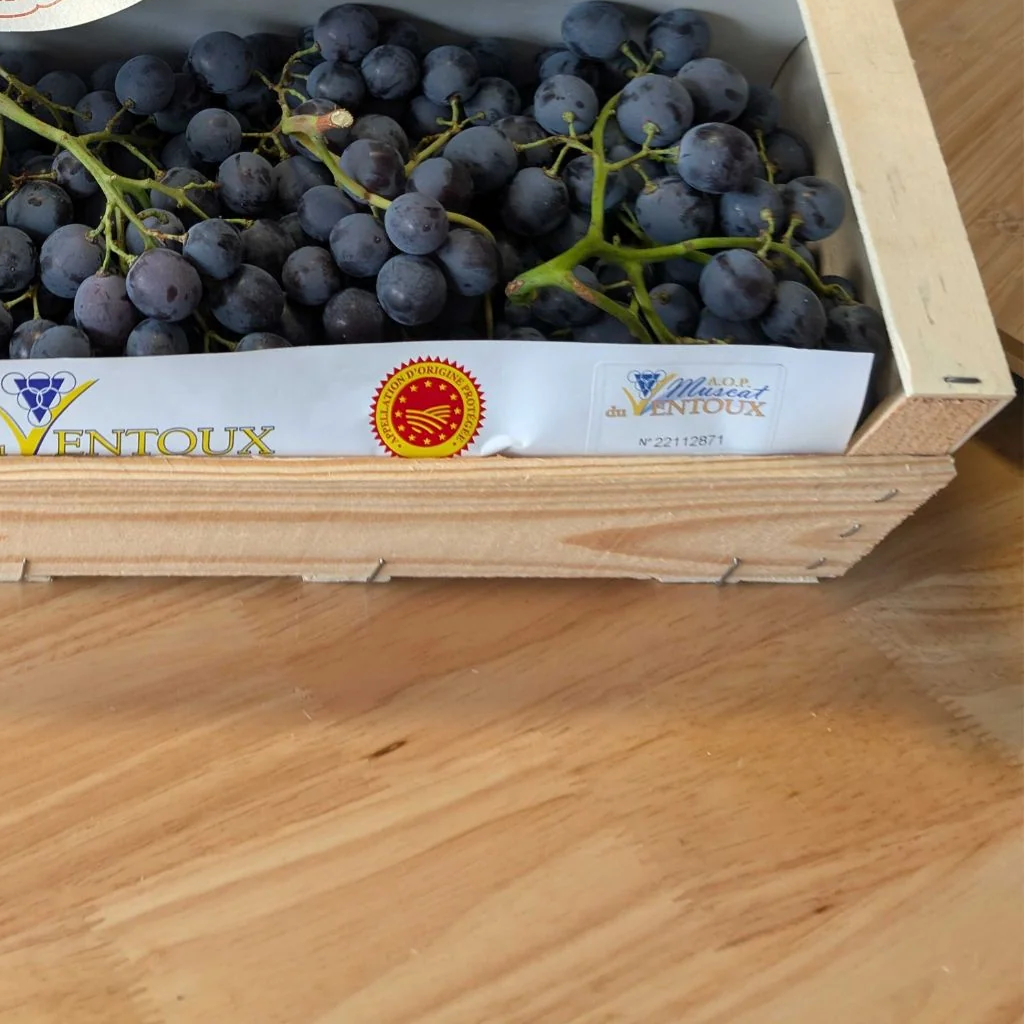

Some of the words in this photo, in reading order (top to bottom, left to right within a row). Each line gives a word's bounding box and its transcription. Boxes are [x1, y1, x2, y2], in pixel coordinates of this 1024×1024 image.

[666, 376, 770, 401] Muscat
[379, 375, 406, 444] APPELLATION
[406, 365, 464, 386] D'ORIGINE
[605, 405, 627, 418] du
